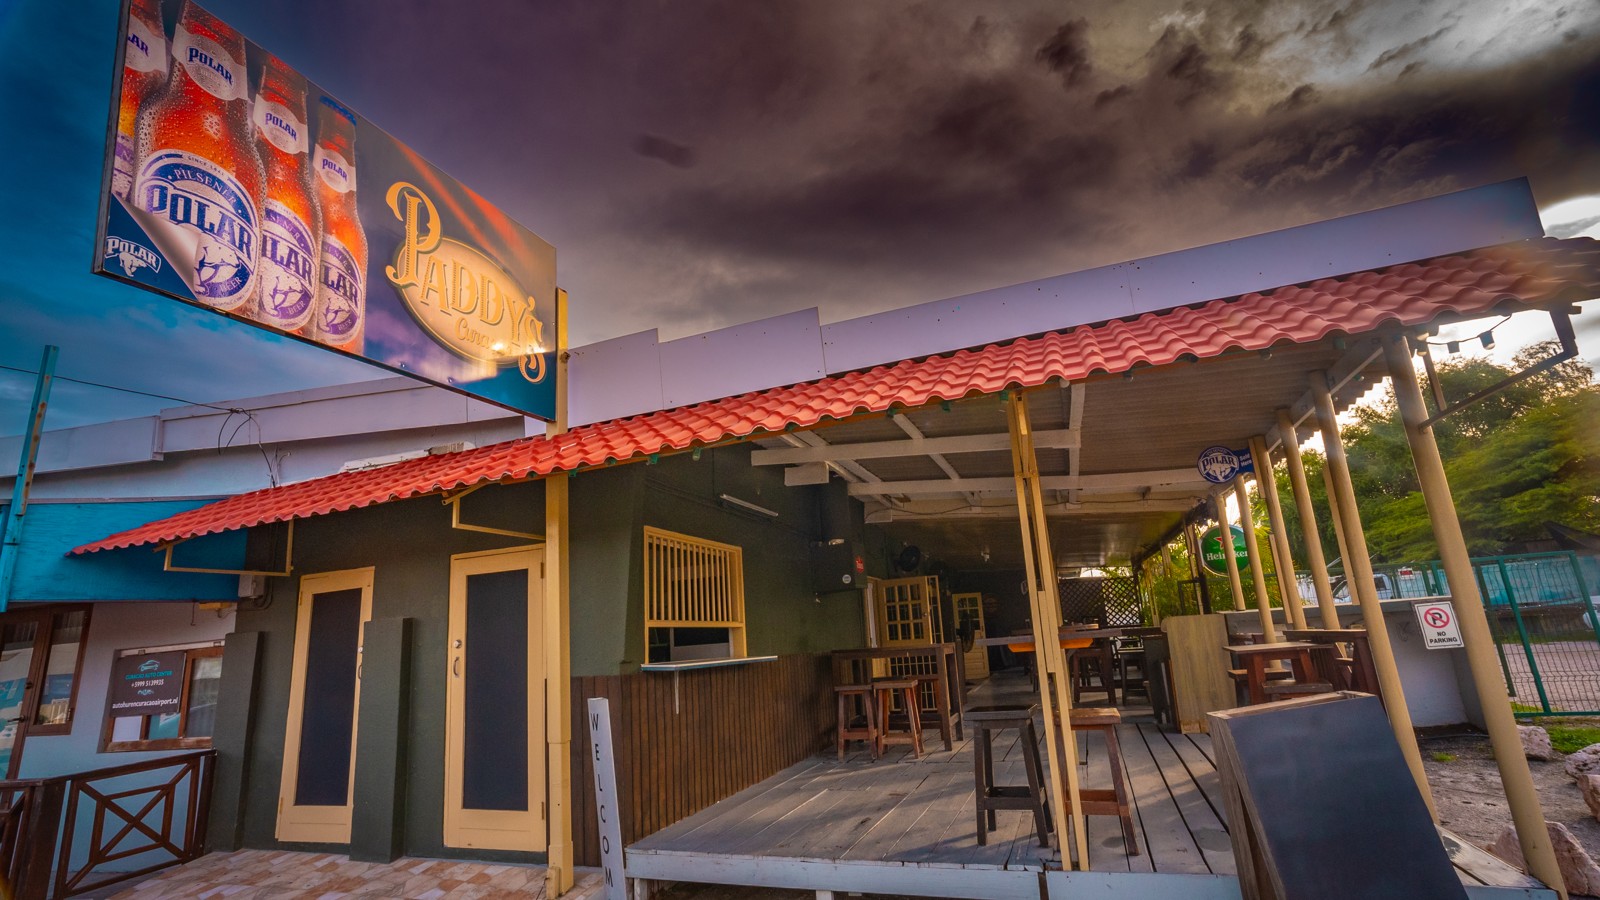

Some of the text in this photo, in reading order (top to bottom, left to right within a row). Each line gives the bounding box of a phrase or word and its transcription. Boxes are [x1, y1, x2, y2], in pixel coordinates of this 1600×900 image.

[128, 33, 149, 57] AR
[188, 47, 233, 86] POLAR
[266, 112, 297, 141] POLAR
[322, 158, 348, 181] POLAR
[146, 185, 252, 262] POLAR
[107, 239, 157, 268] POLAR
[220, 276, 243, 293] BEER
[287, 300, 306, 315] BEER
[337, 318, 353, 331] BEER
[1202, 456, 1236, 471] POLAR
[590, 713, 614, 900] WELCOM
